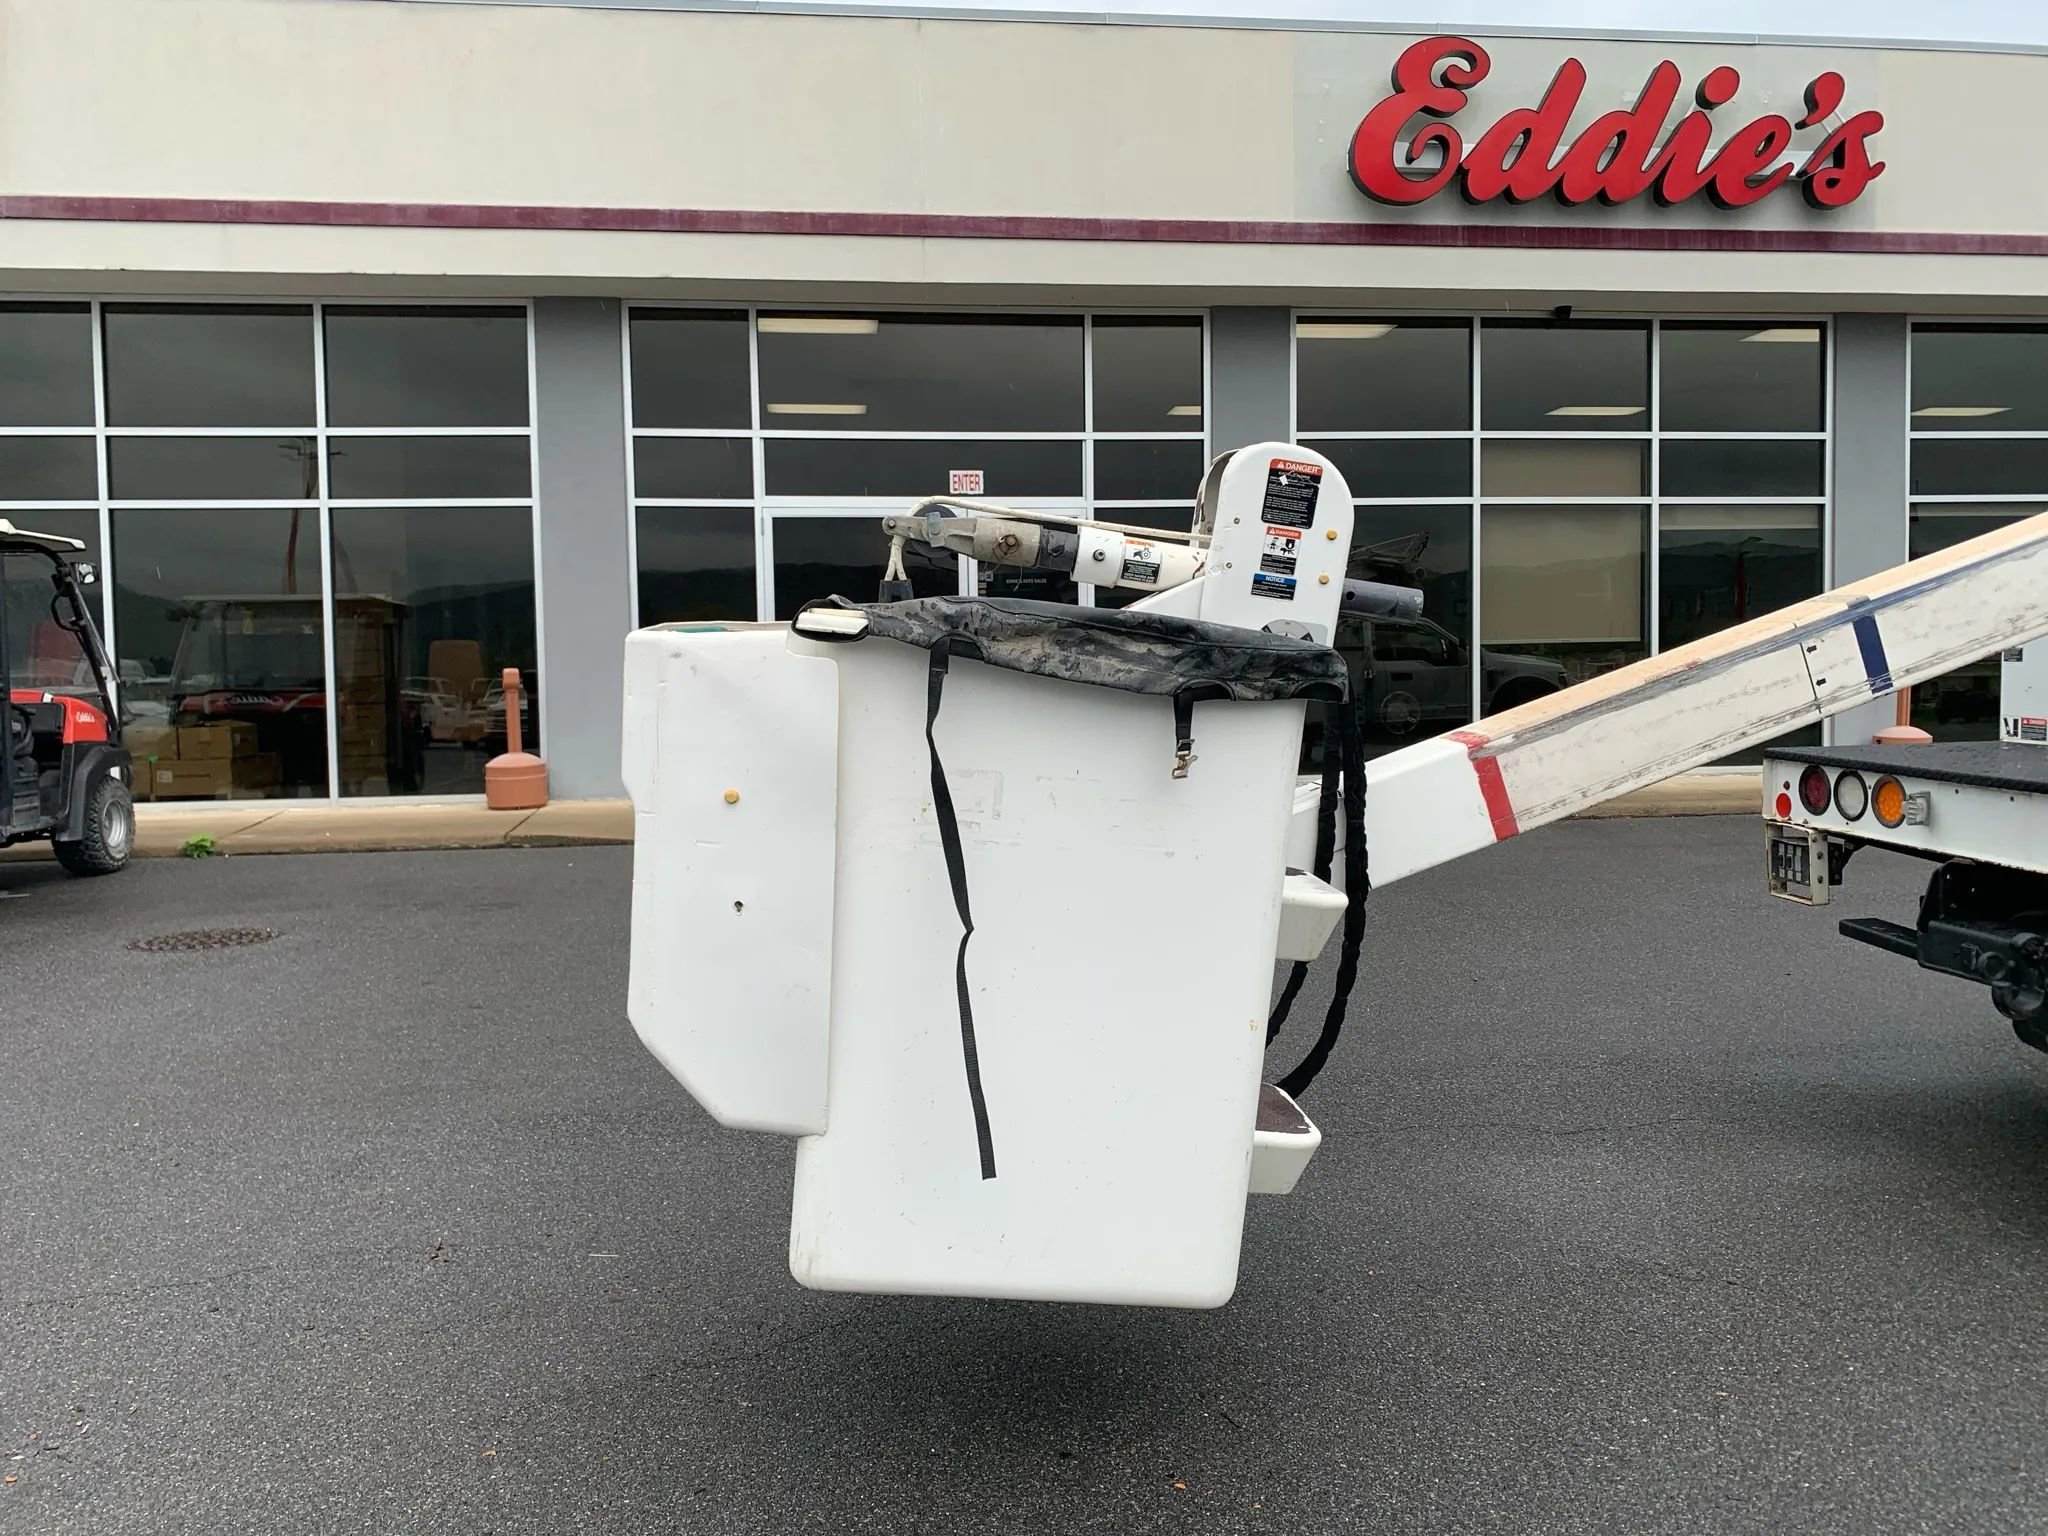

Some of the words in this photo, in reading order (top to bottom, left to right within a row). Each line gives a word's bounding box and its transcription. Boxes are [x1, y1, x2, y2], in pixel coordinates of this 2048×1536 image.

[1350, 36, 1886, 209] Eddie's
[1285, 462, 1318, 474] DANGER
[952, 473, 981, 491] ENTER
[1275, 529, 1299, 537] DANGER
